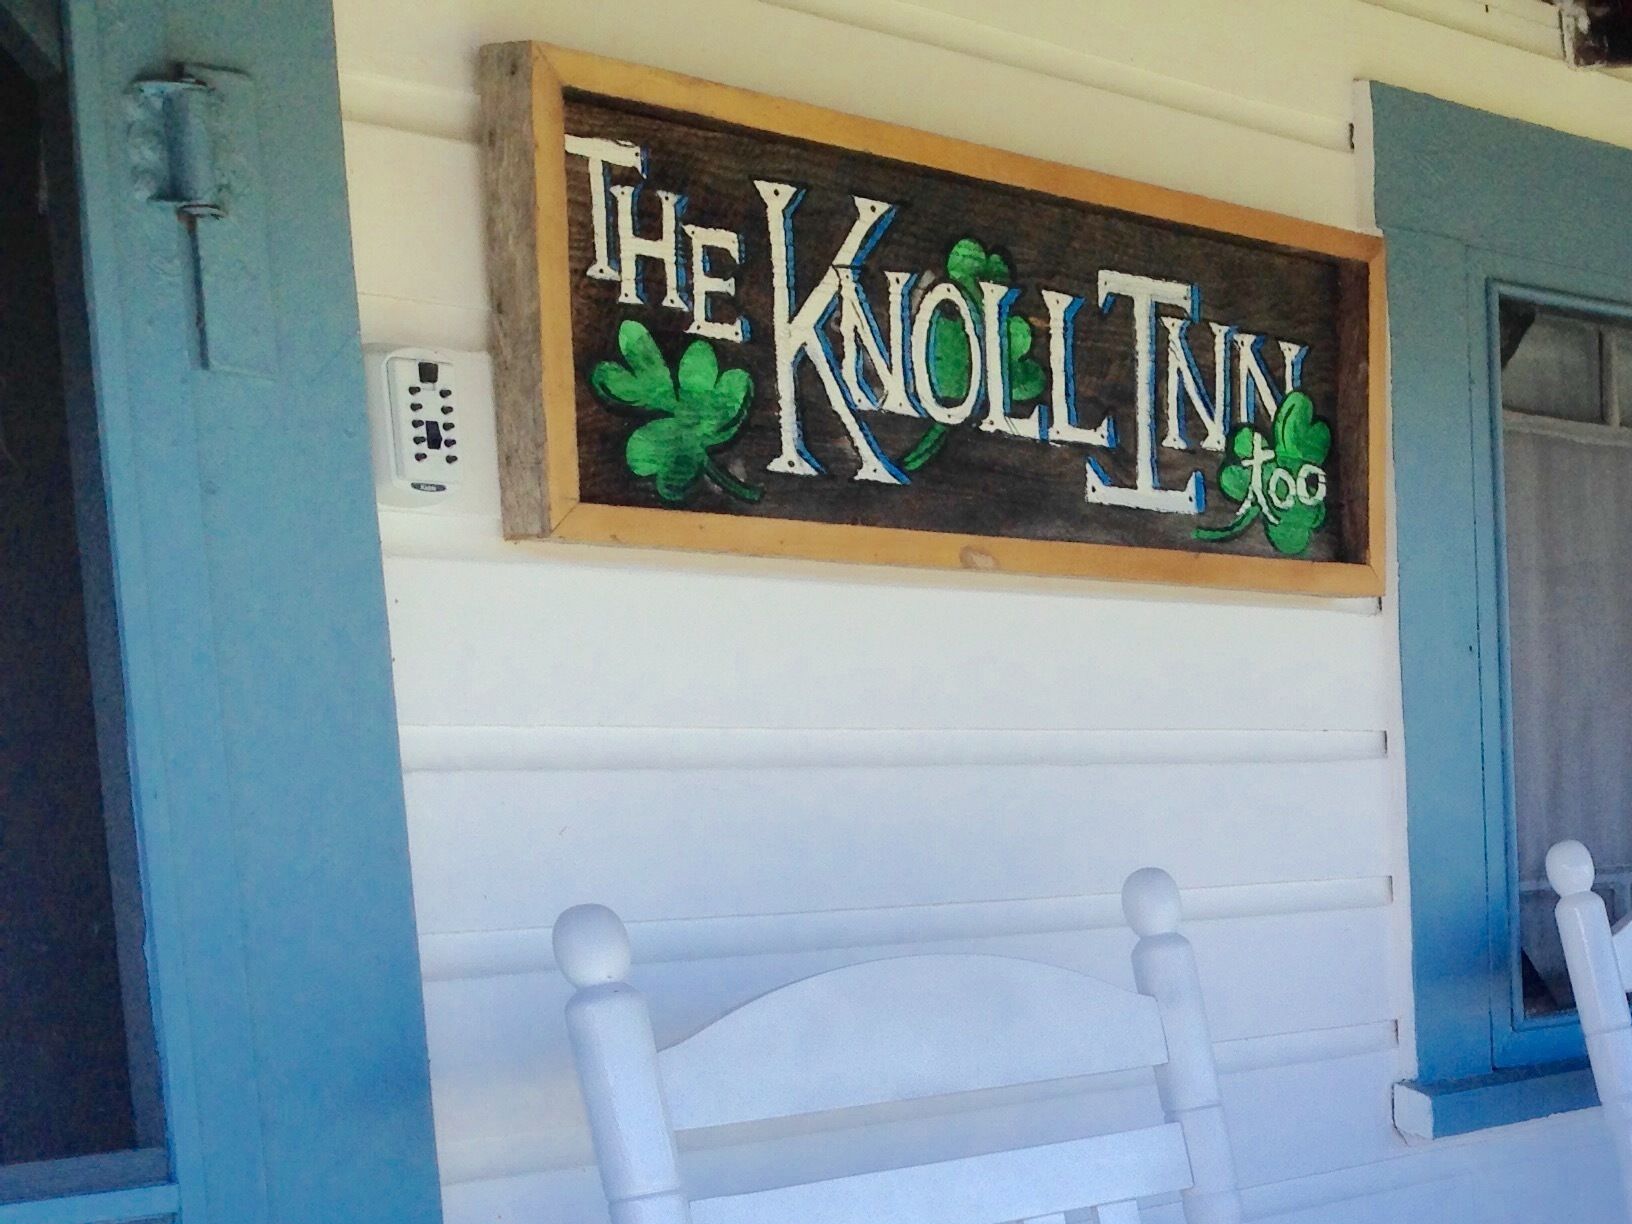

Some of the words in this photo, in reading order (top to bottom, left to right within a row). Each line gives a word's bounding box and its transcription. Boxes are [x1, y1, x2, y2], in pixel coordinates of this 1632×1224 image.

[564, 132, 749, 343] THE
[753, 177, 1117, 486] KNOLL
[1084, 268, 1310, 516] INN
[1236, 431, 1328, 525] too
